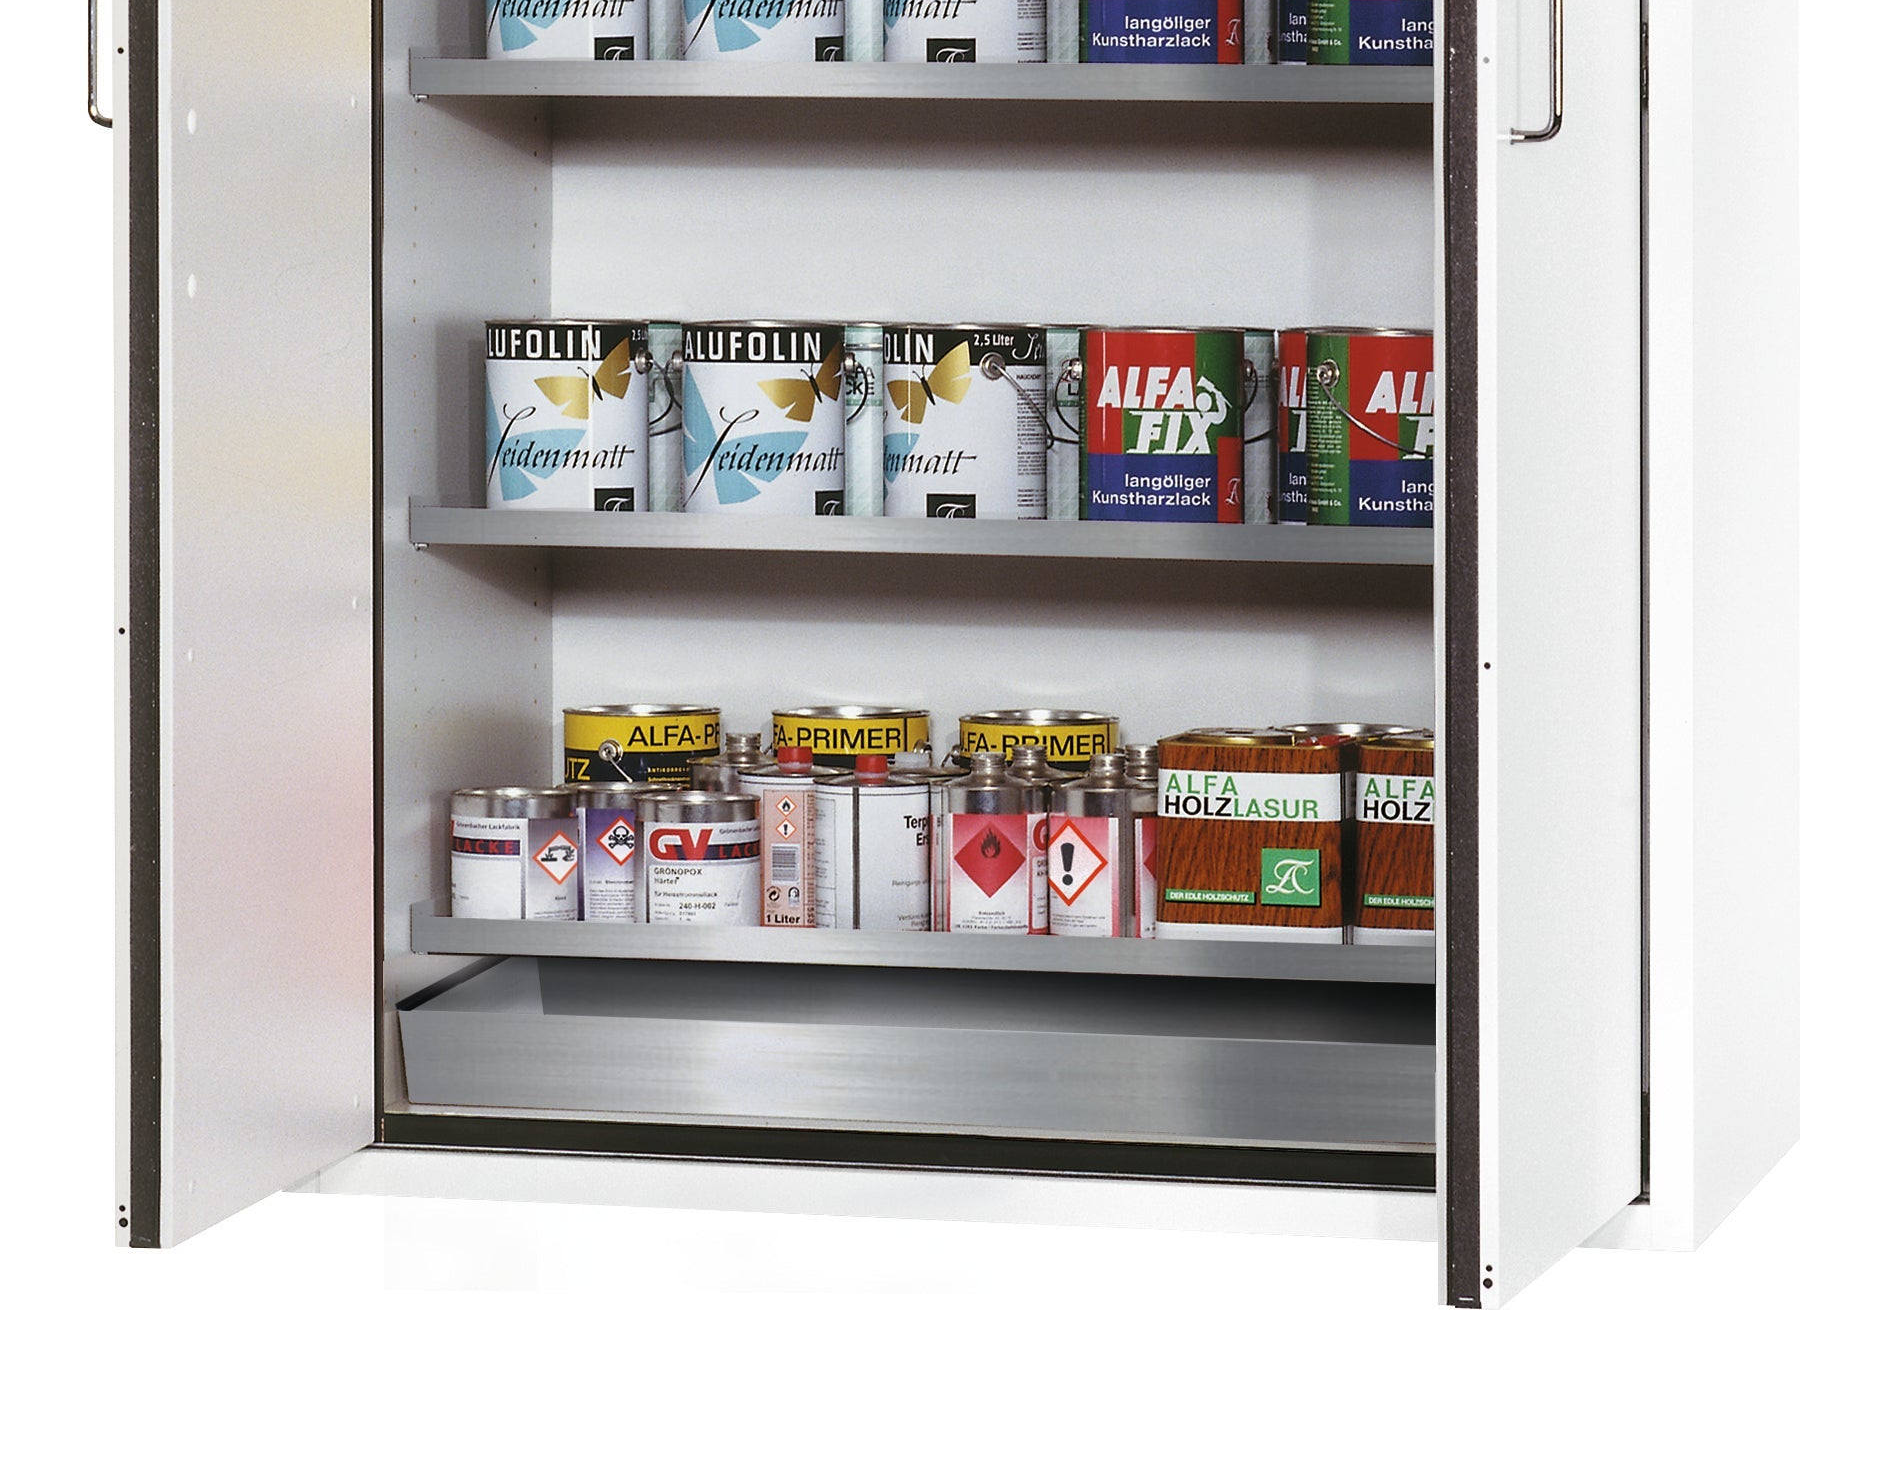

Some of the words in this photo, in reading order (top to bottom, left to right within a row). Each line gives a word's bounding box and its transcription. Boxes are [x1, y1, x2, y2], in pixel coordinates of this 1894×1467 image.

[1124, 14, 1212, 32] langöliger
[1092, 32, 1212, 48] Kunstharzlack
[488, 327, 600, 359] LUFOLIN
[684, 330, 822, 362] ALUFOLIN
[973, 334, 990, 347] 2,5
[992, 333, 1015, 346] Liter
[1096, 365, 1196, 409] ALFA
[1125, 410, 1216, 455] FIX
[1124, 473, 1212, 491] langöliger
[1092, 490, 1212, 506] Kunstharzlack
[1165, 772, 1238, 796] ALFA
[1364, 777, 1434, 800] ALFA
[1164, 794, 1319, 820] HOLZLASUR
[1363, 799, 1434, 822] HOLZ
[455, 838, 514, 855] LACKE
[649, 828, 713, 861] GV
[1169, 891, 1184, 899] DER
[1202, 893, 1249, 902] HOLZSCHUTZ
[766, 914, 771, 924] 1
[774, 914, 801, 924] Liter
